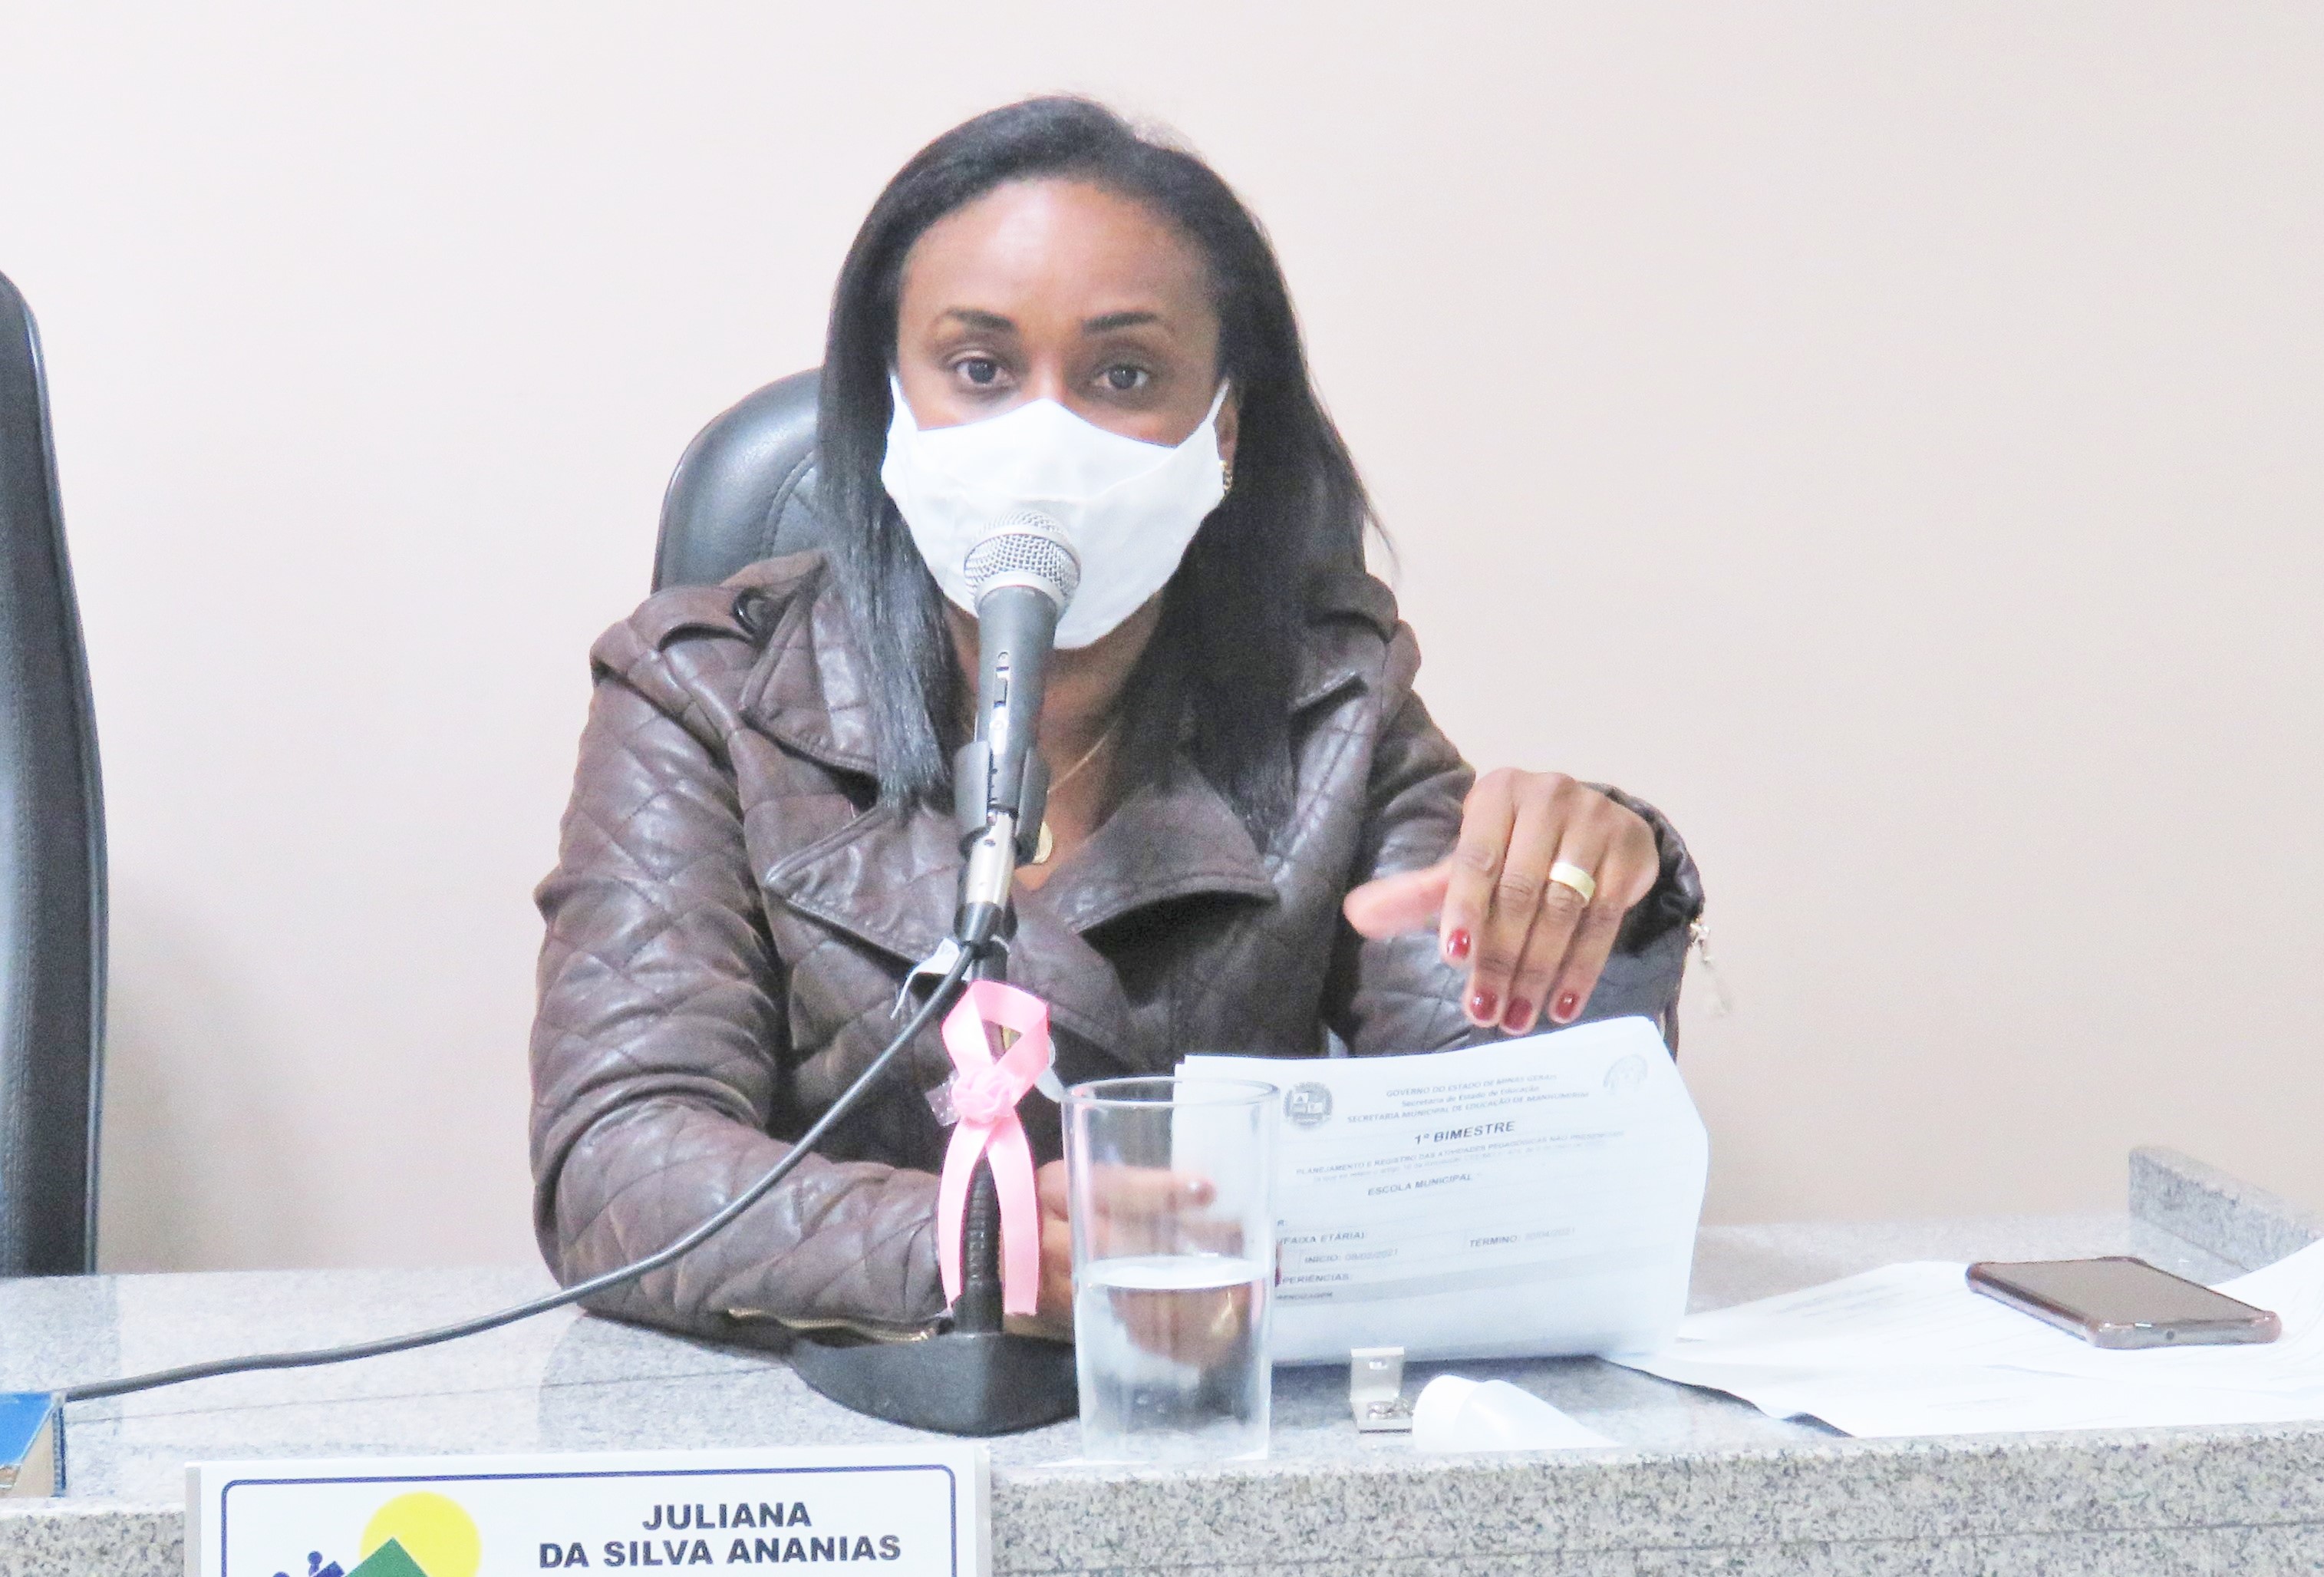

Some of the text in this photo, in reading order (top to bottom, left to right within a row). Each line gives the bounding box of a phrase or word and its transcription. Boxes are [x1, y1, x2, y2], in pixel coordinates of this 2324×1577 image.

[1386, 1087, 1430, 1097] GOVERNO
[1448, 1080, 1482, 1091] ESTADO
[1402, 1097, 1444, 1107] Secretaria
[1446, 1094, 1456, 1103] de
[1459, 1090, 1486, 1101] Estado
[1347, 1111, 1400, 1123] SECRETARIA
[1402, 1107, 1449, 1119] MUNICIPAL
[1452, 1104, 1463, 1113] DE
[1434, 1120, 1516, 1143] BIMESTRE
[1367, 1173, 1472, 1196] ESCOLA MUNICIPAL
[642, 1502, 813, 1530] JULIANA
[539, 1534, 902, 1568] DA SILVA ANANIAS
